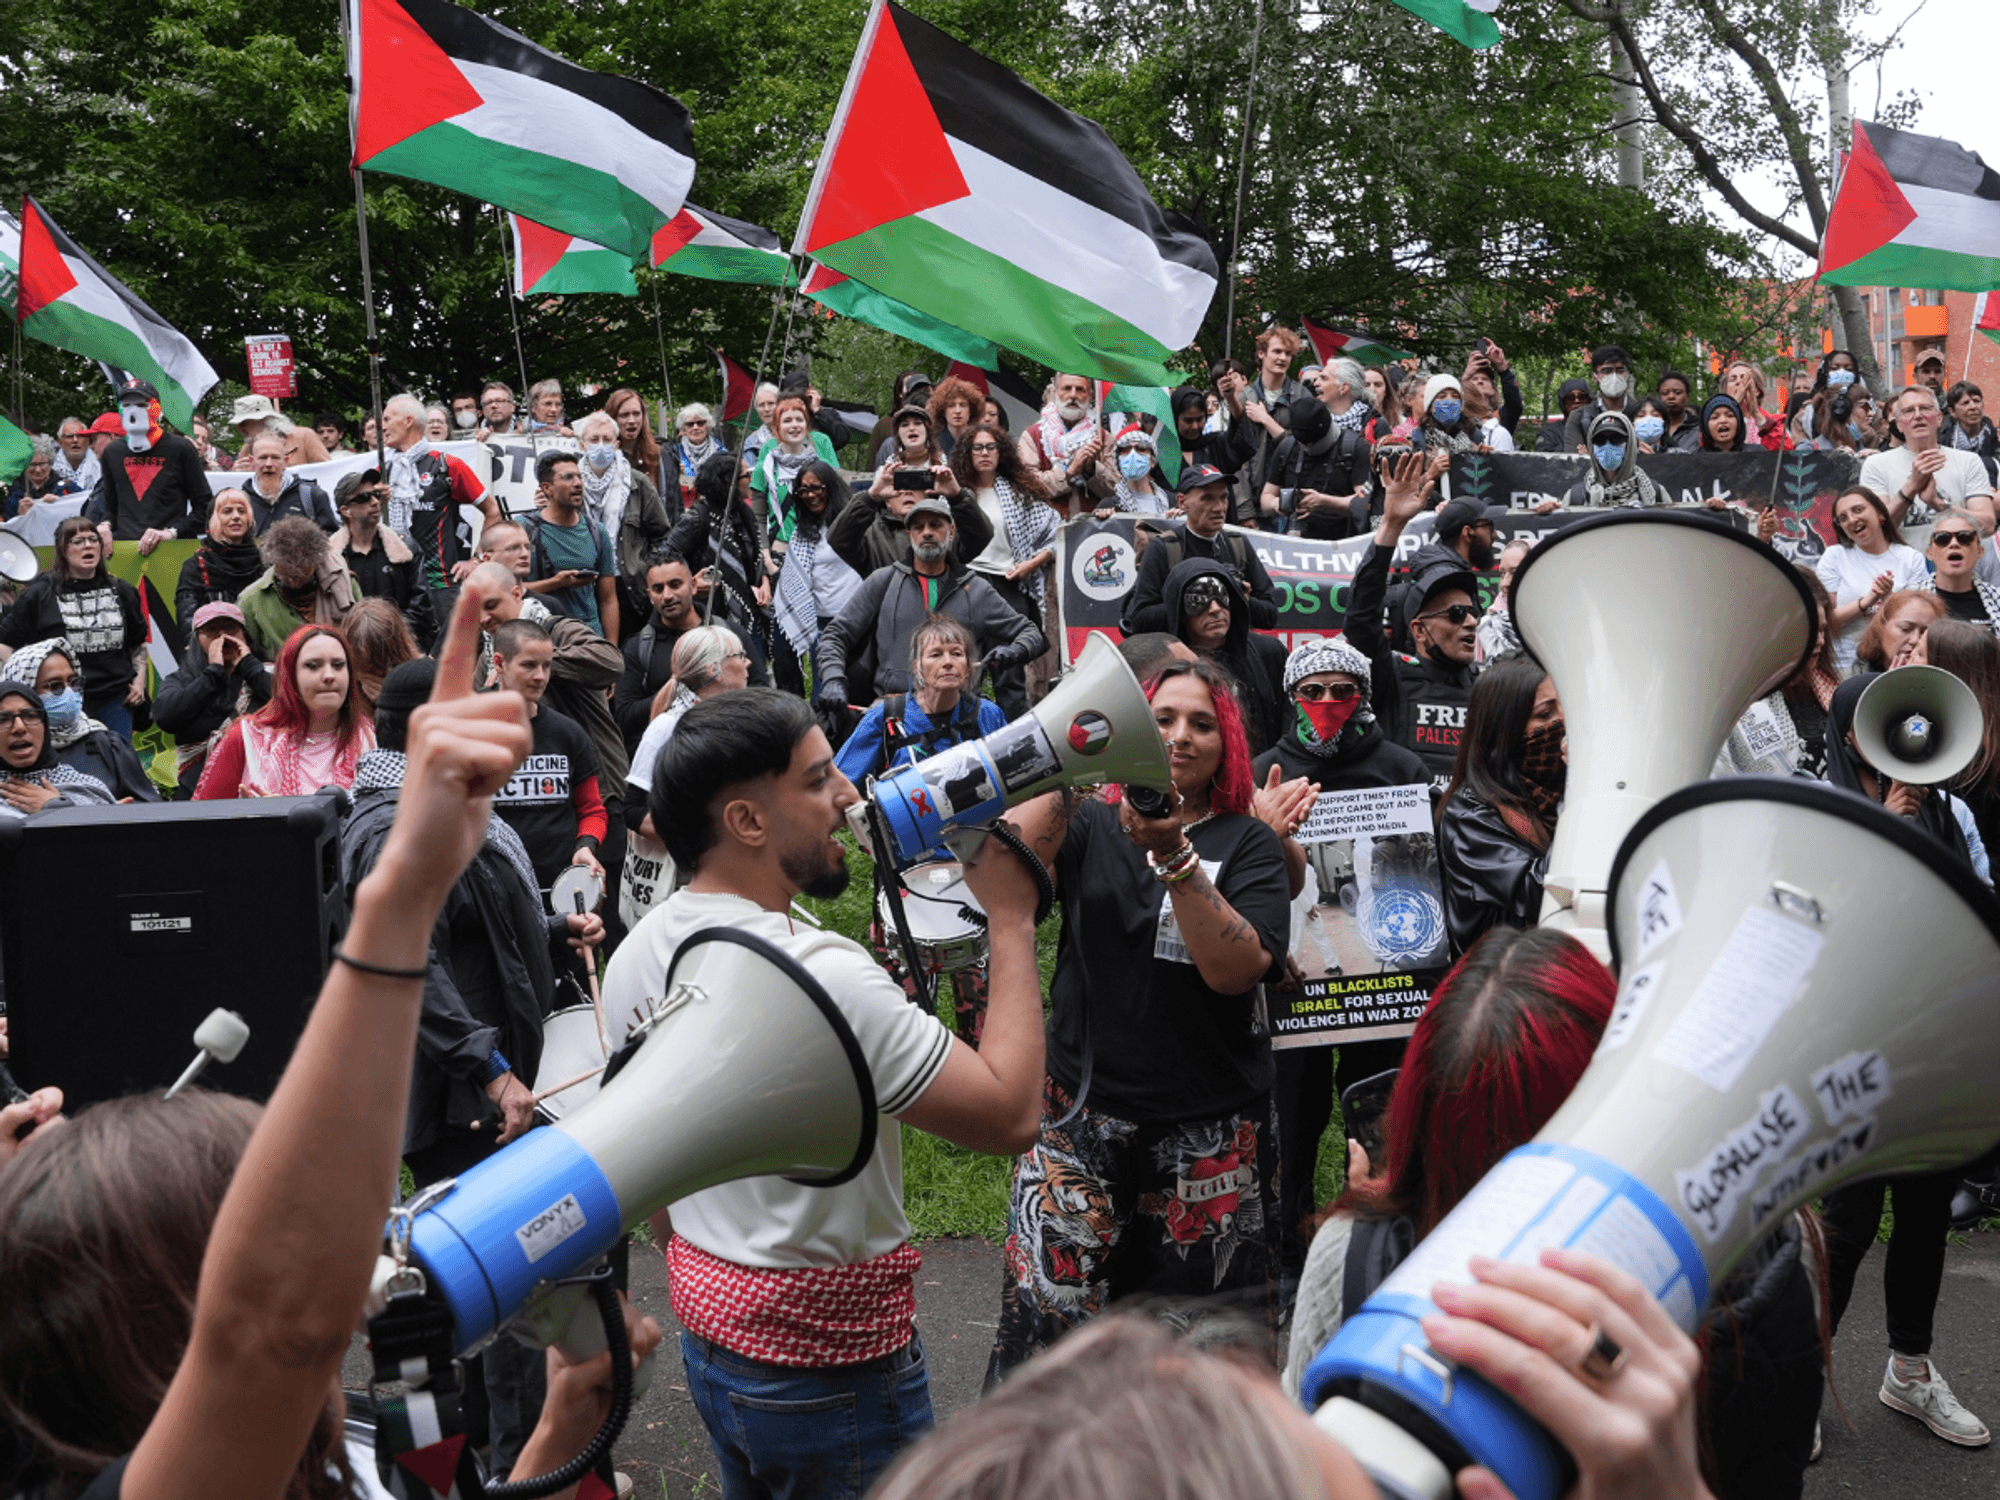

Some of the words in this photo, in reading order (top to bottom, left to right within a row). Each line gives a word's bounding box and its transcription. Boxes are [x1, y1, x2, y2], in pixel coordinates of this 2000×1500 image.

[124, 456, 167, 466] RESIST
[1416, 704, 1469, 728] FRE
[1416, 726, 1464, 746] PALES
[495, 776, 568, 797] CTION
[1363, 791, 1390, 801] THIS?
[1391, 789, 1418, 798] FROM
[1346, 803, 1373, 814] CAME
[1375, 801, 1395, 810] OUT
[1397, 799, 1418, 808] AND
[1293, 826, 1353, 840] OVERNMENT
[1355, 823, 1376, 833] AND
[1378, 821, 1408, 830] MEDIA
[1301, 818, 1321, 829] VER
[1323, 814, 1374, 826] REPORTED
[1376, 812, 1388, 821] BY
[141, 920, 182, 930] 101121
[1304, 983, 1326, 996] UN
[1328, 975, 1414, 995] BLACKLISTS
[1291, 998, 1342, 1014] ISRAEL
[1344, 995, 1373, 1008] FOR
[1375, 989, 1432, 1006] SEXUAL
[1276, 1013, 1347, 1031] VIOLENCE
[1349, 1011, 1365, 1023] IN
[1366, 1008, 1400, 1021] WAR
[1684, 1092, 1797, 1231] GLOBALISE
[1816, 1053, 1879, 1111] THE
[521, 1197, 575, 1238] VONYX
